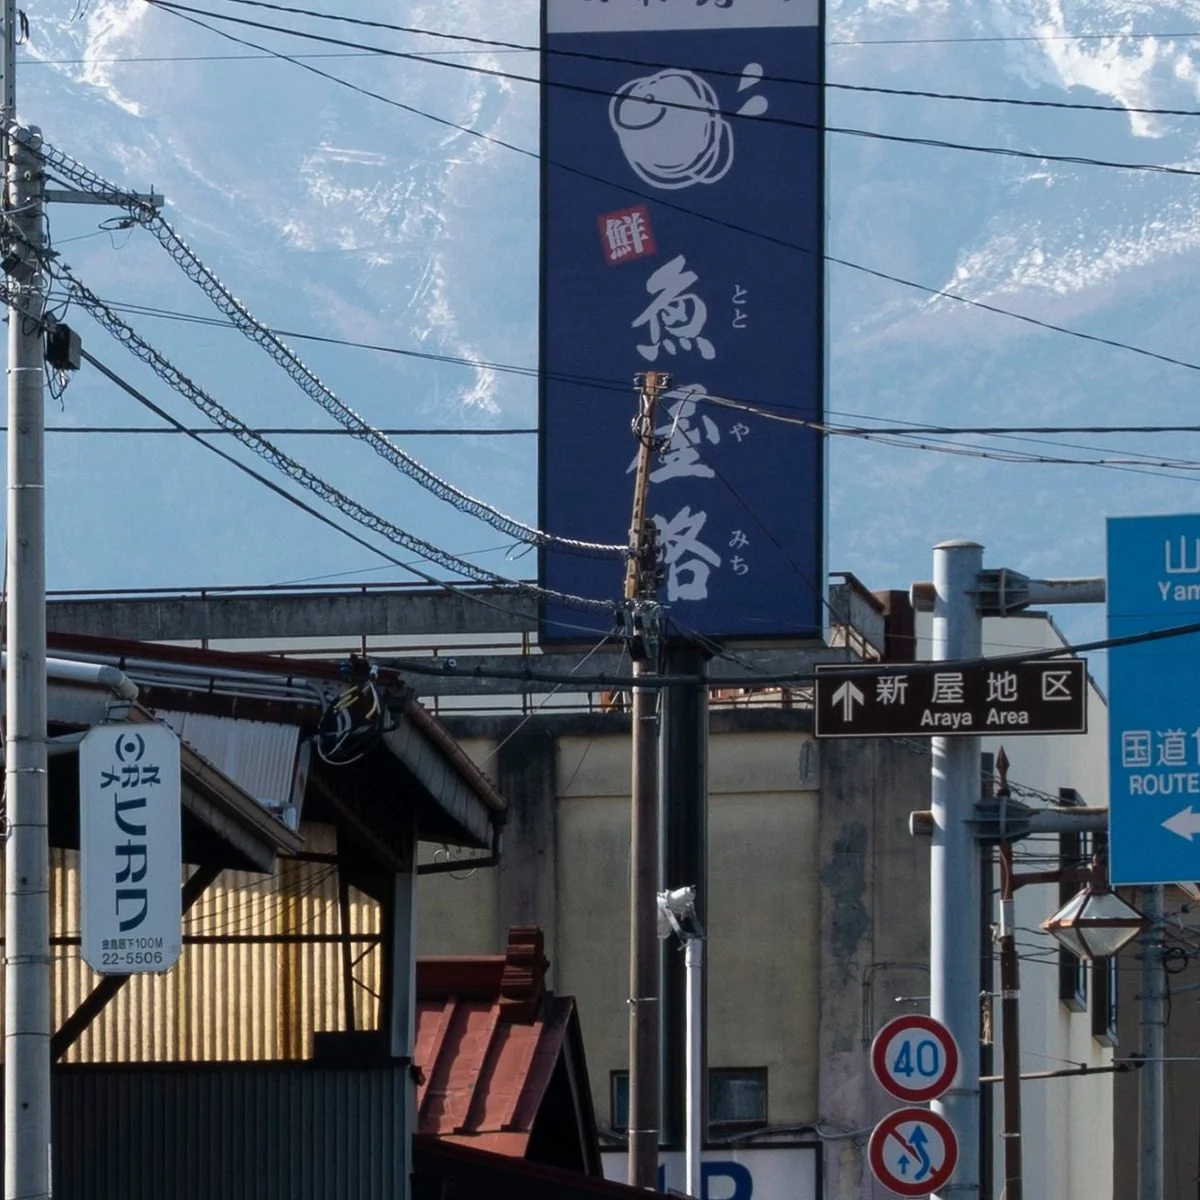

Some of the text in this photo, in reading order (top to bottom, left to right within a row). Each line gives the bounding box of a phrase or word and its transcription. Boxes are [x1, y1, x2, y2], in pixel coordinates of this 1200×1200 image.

[605, 212, 648, 260] 鮮
[875, 670, 1073, 705] 新屋地区
[920, 707, 1029, 730] Araya Area
[1129, 772, 1200, 796] ROUTE
[102, 951, 163, 965] 22-5506
[893, 1040, 939, 1077] 40
